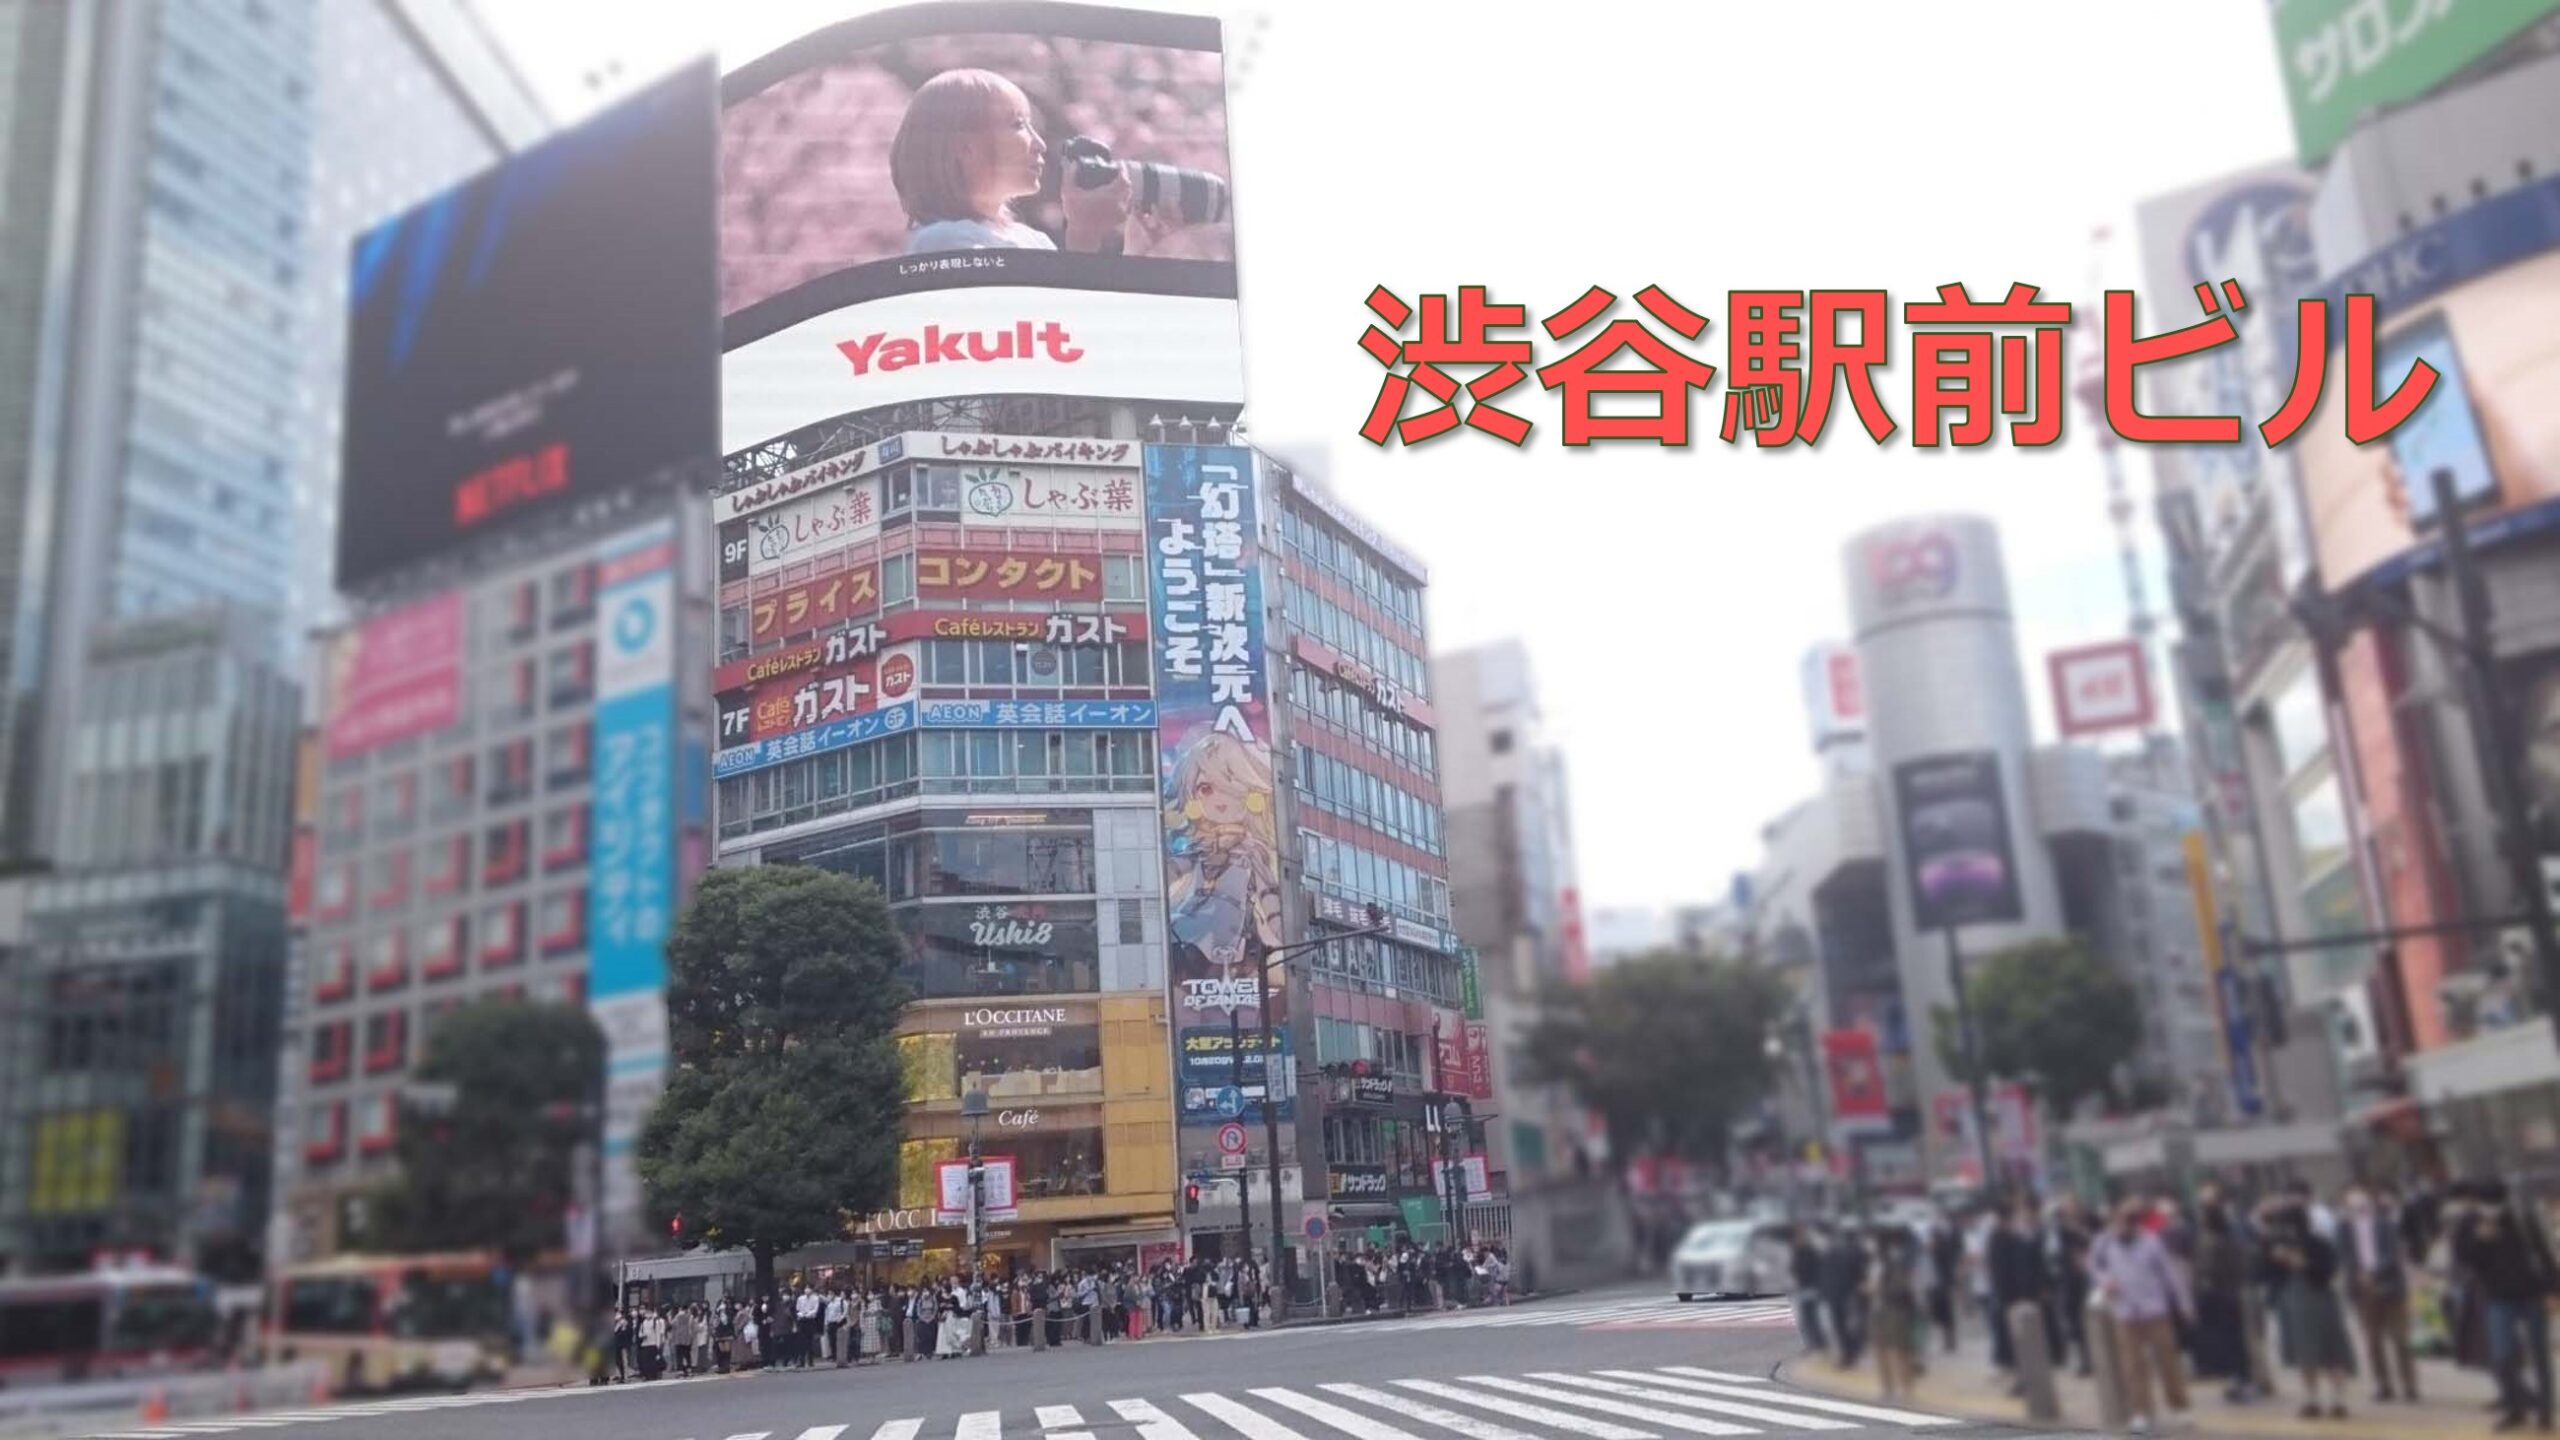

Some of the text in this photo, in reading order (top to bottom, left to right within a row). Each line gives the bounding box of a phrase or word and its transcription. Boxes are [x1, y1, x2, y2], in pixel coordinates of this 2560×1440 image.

[899, 256, 1005, 275] しっかり表現しないと
[837, 321, 1085, 376] Yakult
[941, 435, 1129, 463] しゃぶしゃぶバイキング
[1024, 478, 1134, 511] しゃぶ葉
[794, 490, 872, 543] しゃぶ葉
[724, 538, 748, 564] 9F
[918, 556, 1096, 590] コンタクト
[753, 570, 876, 635] プライス
[1158, 518, 1203, 675] ようこそ
[1046, 614, 1127, 643] ガスト
[825, 623, 888, 665] ガスト
[757, 696, 791, 719] Café
[793, 674, 870, 727] ガスト
[930, 705, 982, 720] AEON
[722, 707, 750, 736] 7F
[719, 750, 756, 769] AEON
[976, 904, 1009, 919] 渋谷
[969, 920, 1054, 946] Ushi8
[1443, 931, 1458, 953] 4F
[964, 1008, 1066, 1025] L'OCCITANE
[998, 1109, 1039, 1129] Café
